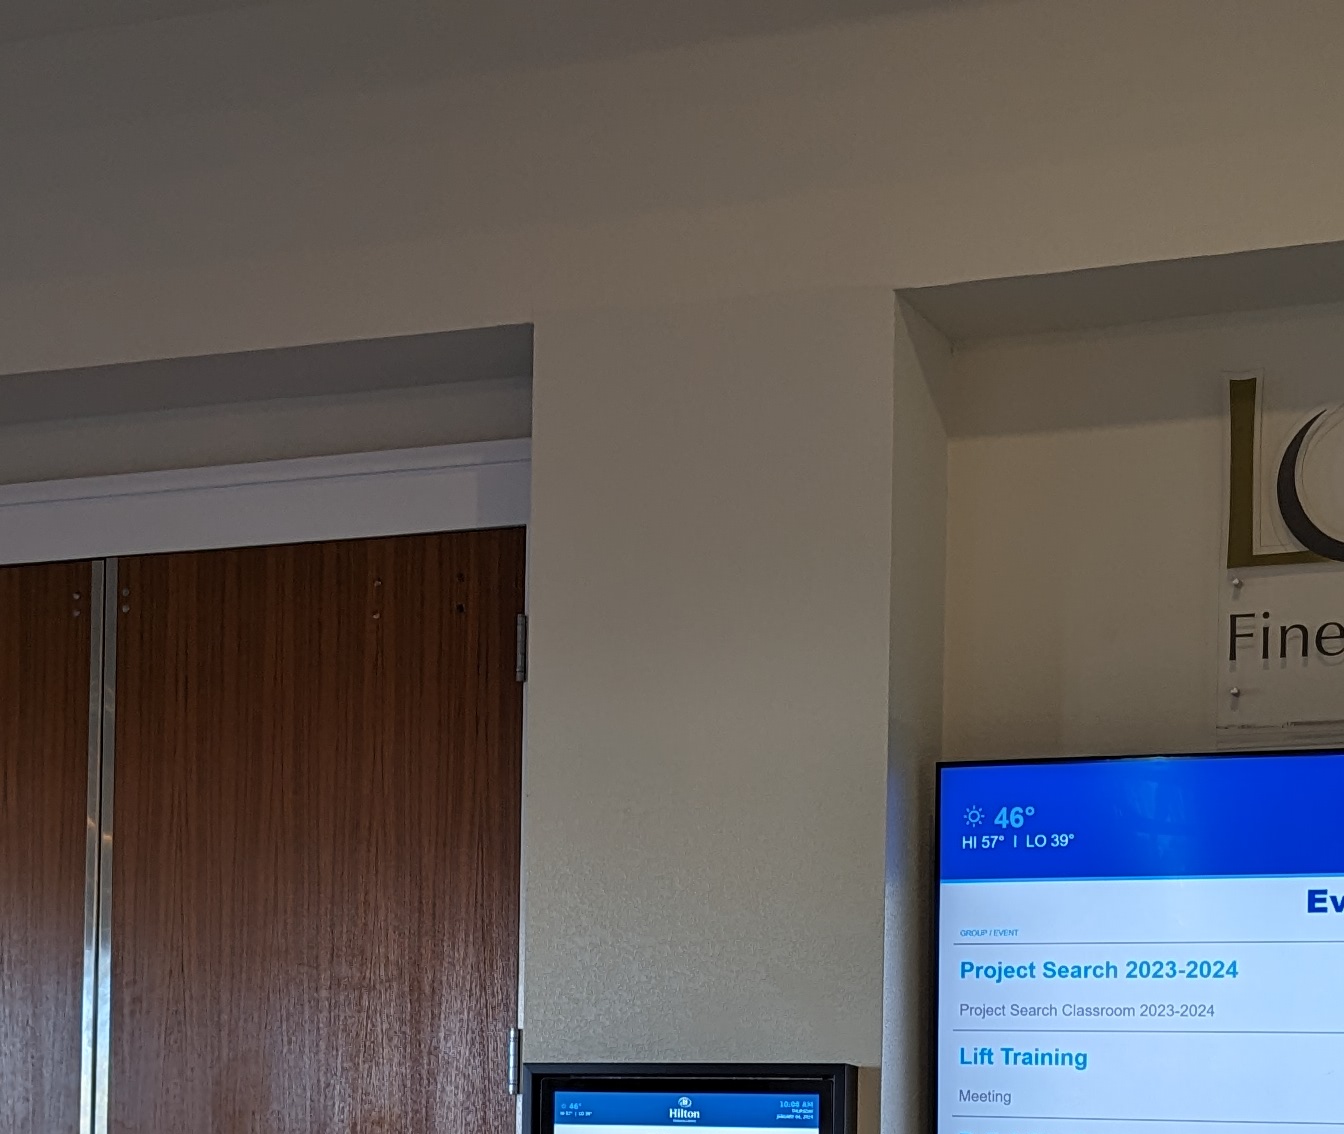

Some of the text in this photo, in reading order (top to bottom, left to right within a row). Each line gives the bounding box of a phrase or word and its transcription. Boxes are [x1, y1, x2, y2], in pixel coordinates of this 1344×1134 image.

[994, 806, 1035, 829] 46°
[962, 835, 977, 849] HI
[981, 834, 1005, 849] 57°
[1026, 834, 1047, 848] LO
[1050, 833, 1075, 847] 39°
[994, 929, 1019, 937] EVENT
[960, 960, 1239, 983] Project Search 2023-2024
[959, 1003, 1215, 1020] Project Search Classroom 2023-2024
[959, 1047, 1088, 1071] Lift Training
[959, 1090, 1012, 1106] Meeting
[669, 1108, 701, 1119] Hilton
